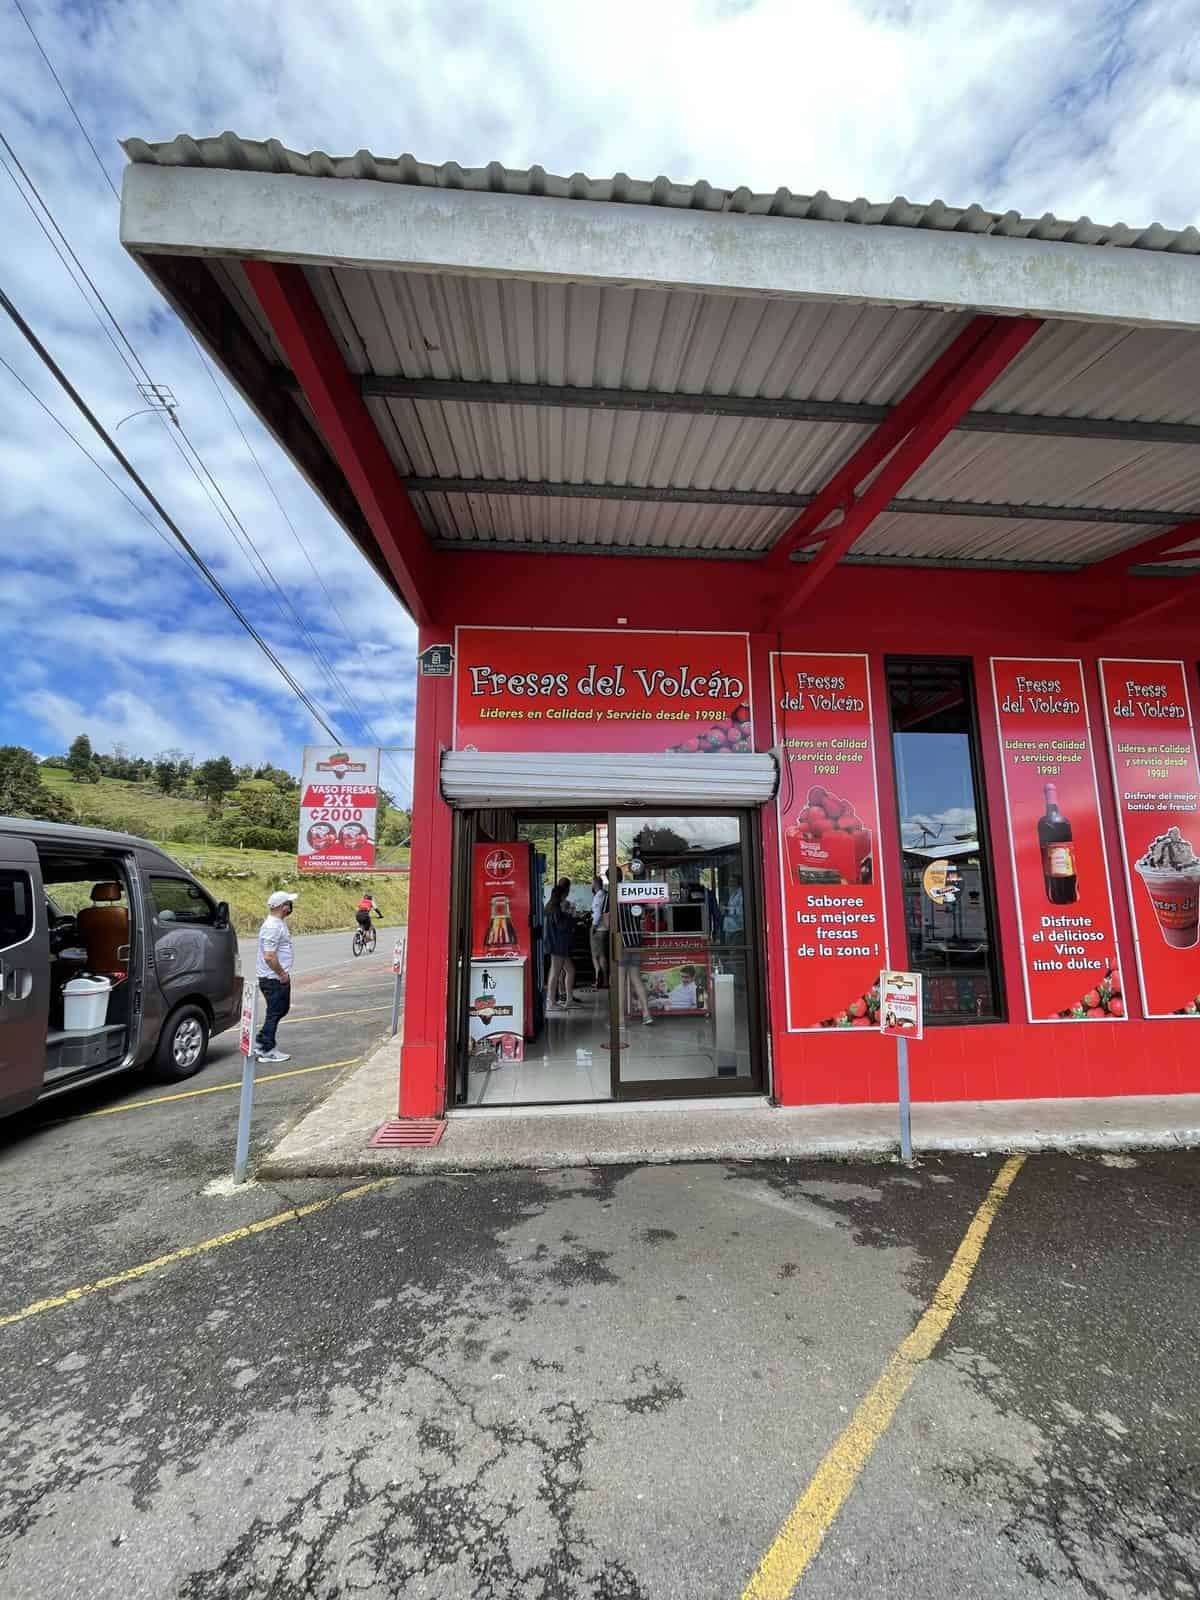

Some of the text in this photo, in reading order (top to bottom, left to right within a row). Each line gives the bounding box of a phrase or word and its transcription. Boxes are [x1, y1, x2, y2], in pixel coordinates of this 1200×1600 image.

[468, 664, 744, 698] Fresas del Volcán
[797, 672, 846, 690] Fresas
[1015, 676, 1062, 694] Fresas
[1125, 681, 1168, 698] Fresas
[780, 691, 805, 711] del
[1002, 695, 1080, 714] del Volcán
[527, 710, 542, 719] en
[546, 708, 593, 719] Calidad
[596, 710, 604, 721] y
[606, 708, 653, 720] Servicio
[656, 709, 690, 720] desde
[1113, 699, 1135, 717] del
[817, 740, 828, 748] en
[831, 739, 867, 749] Calidad
[1051, 740, 1086, 750] Calidad
[1147, 745, 1158, 753] en
[1159, 744, 1192, 753] Calidad
[789, 752, 864, 763] y servicio desde
[1014, 752, 1082, 764] y servicio desde
[1164, 757, 1189, 766] desde
[814, 764, 840, 775] 1998!
[1036, 765, 1062, 775] 1998!
[311, 785, 377, 794] VASO FRESAS
[323, 793, 355, 807] 2X1
[1124, 791, 1197, 802] Disfrute del mejor
[1127, 802, 1155, 811] batido
[1157, 802, 1168, 811] de
[621, 886, 665, 897] EMPUJE
[807, 894, 864, 907] Saboree
[797, 910, 876, 926] las mejores
[1041, 915, 1092, 928] Disfrute
[816, 926, 858, 939] fresas
[1032, 929, 1105, 942] el delicioso
[798, 943, 815, 957] de
[819, 943, 833, 956] la
[836, 946, 870, 957] zona
[1054, 944, 1085, 956] Vino
[1033, 959, 1064, 971] tinto
[1067, 957, 1102, 970] dulce
